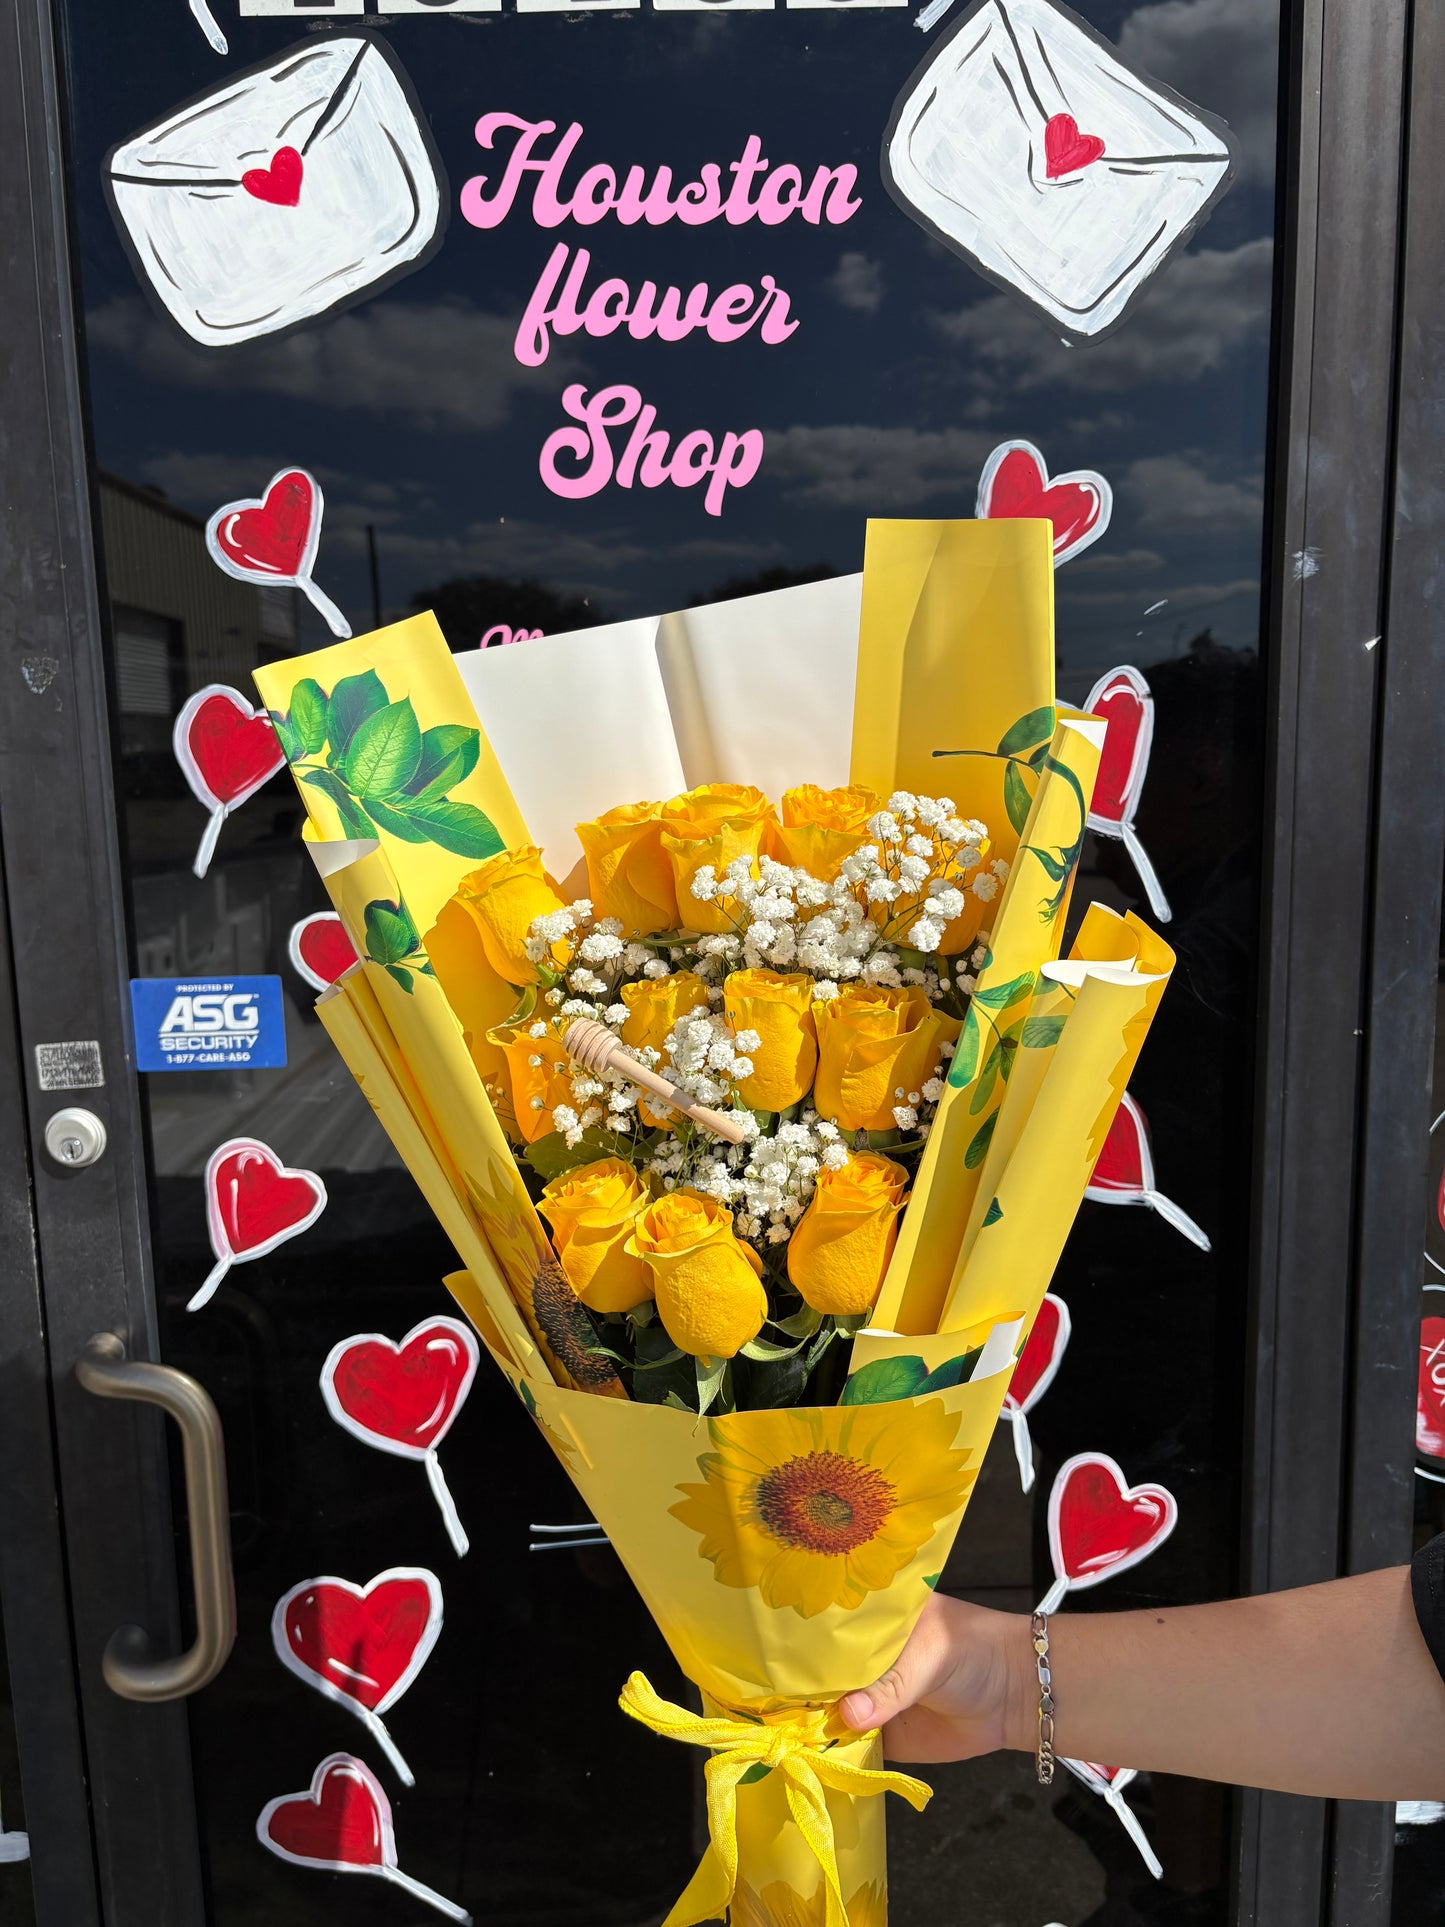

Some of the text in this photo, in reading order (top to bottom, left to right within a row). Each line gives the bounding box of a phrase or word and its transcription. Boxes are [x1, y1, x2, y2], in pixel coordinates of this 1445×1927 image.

[460, 112, 862, 229] Houston
[514, 242, 800, 367] flower
[539, 383, 764, 516] Shop
[176, 983, 234, 993] PROTECTED BY
[159, 993, 260, 1032] ASG
[160, 1035, 258, 1051] SECURITY
[166, 1052, 251, 1064] 1-877-CARE-ASG
